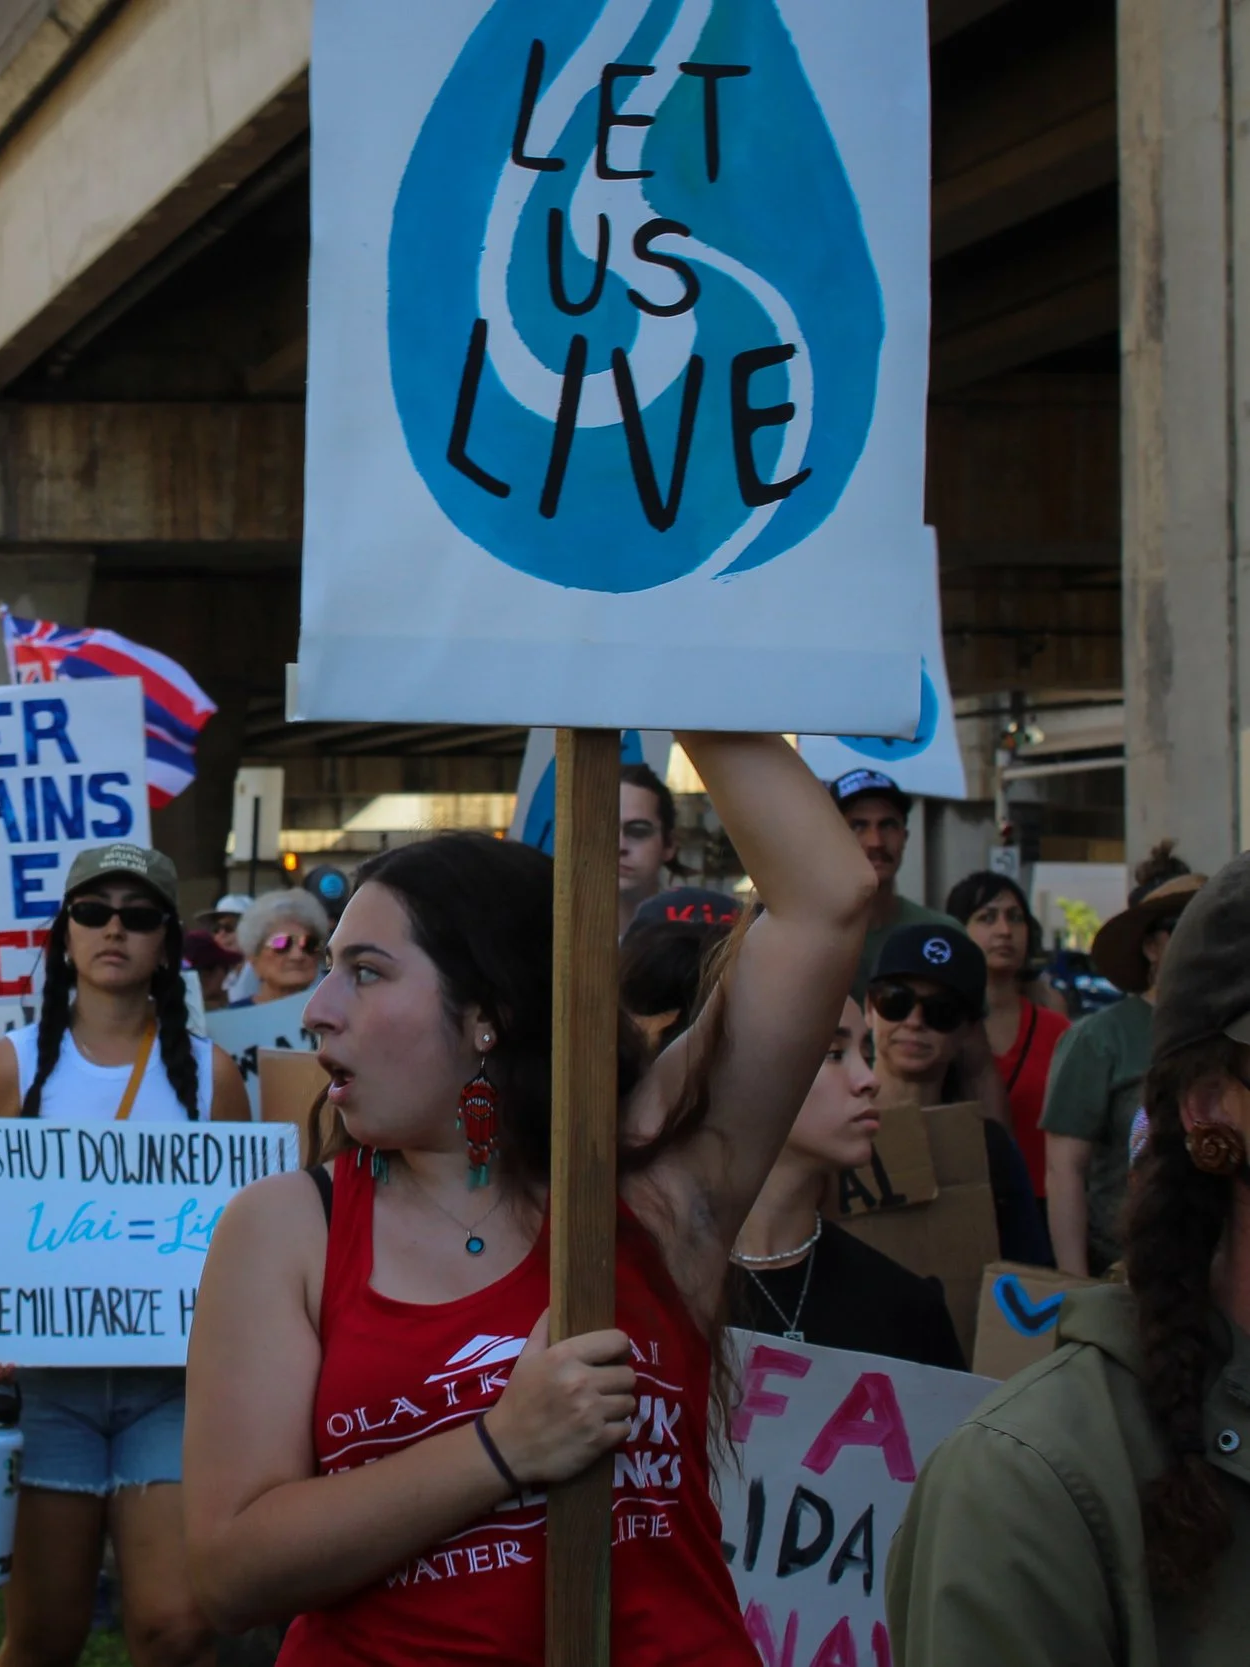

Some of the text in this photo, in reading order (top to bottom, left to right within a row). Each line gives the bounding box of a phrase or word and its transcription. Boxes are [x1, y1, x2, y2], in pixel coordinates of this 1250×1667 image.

[510, 38, 750, 184] LET
[547, 207, 702, 317] US
[445, 318, 812, 533] LIVE
[78, 1129, 164, 1186] DOWN
[170, 1132, 224, 1187] RED
[26, 1199, 123, 1253] Wai
[326, 1395, 428, 1438] OLA
[730, 1344, 917, 1483] FA
[386, 1512, 672, 1590] WATER IFE
[720, 1475, 876, 1598] IDA
